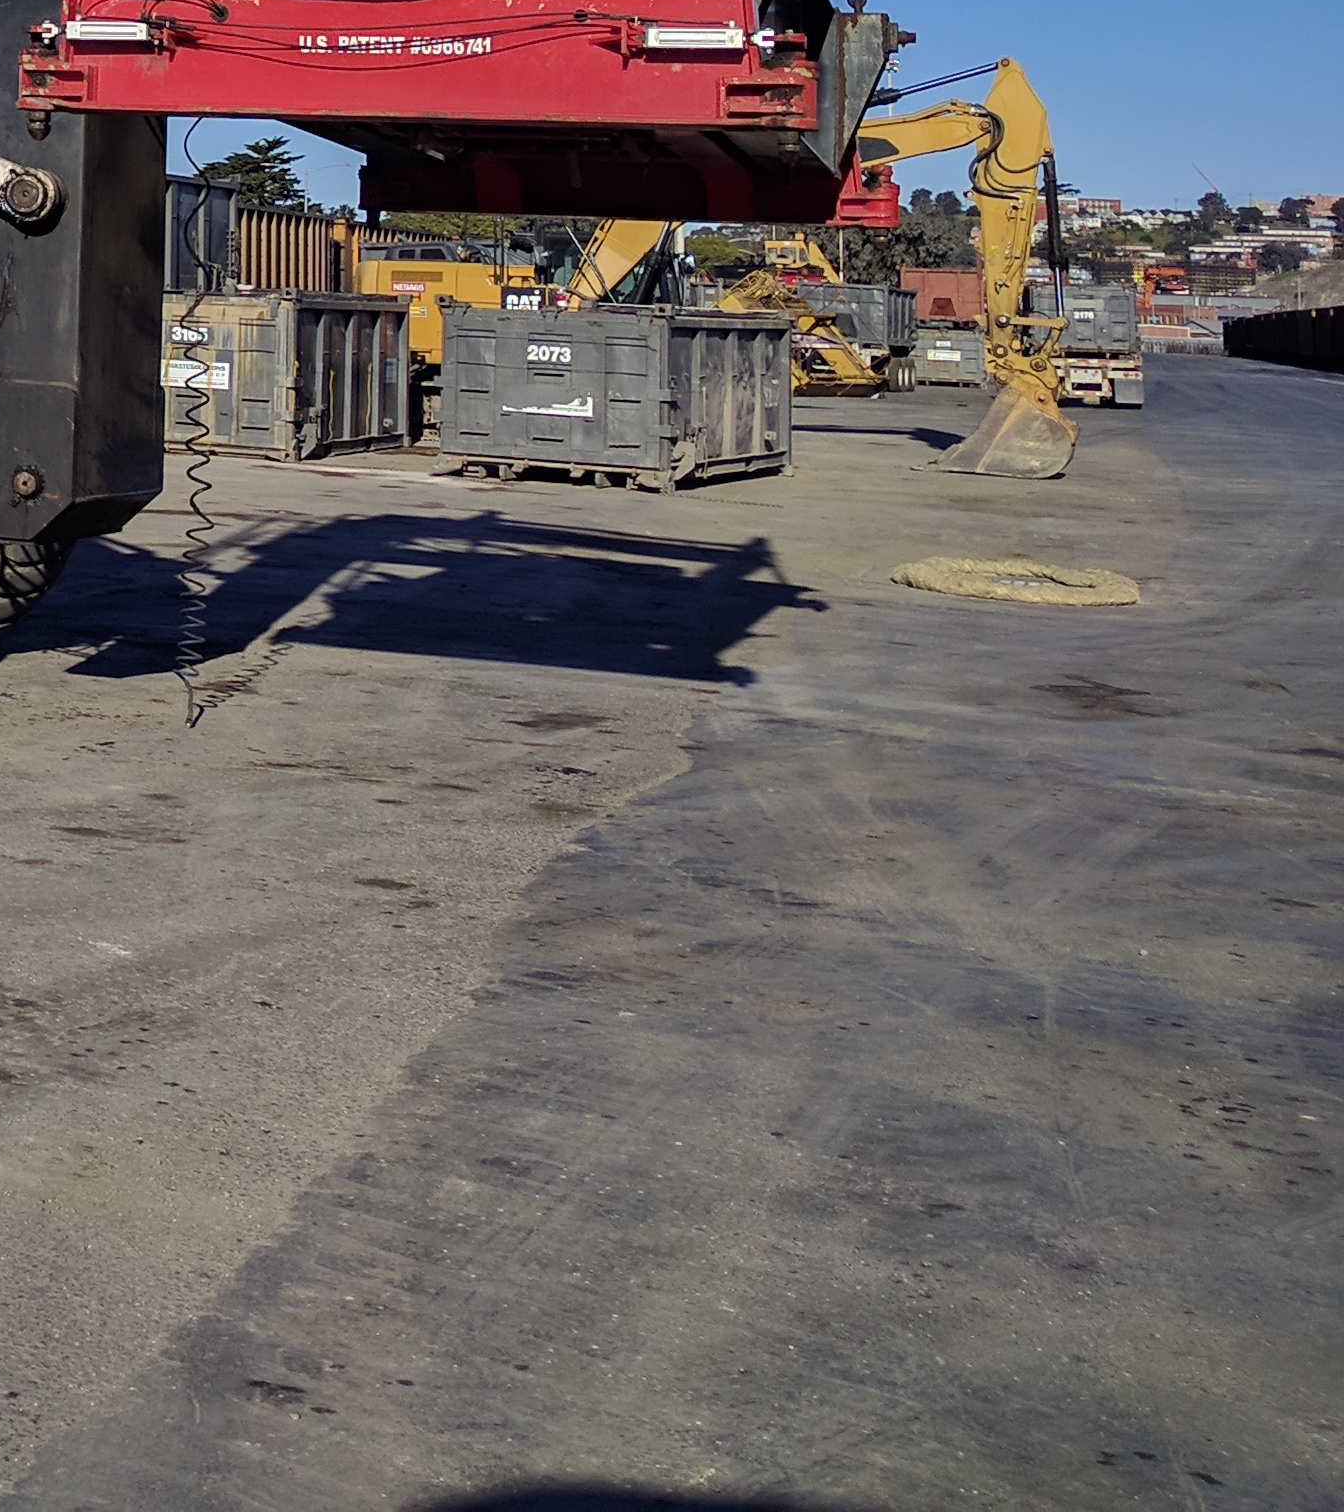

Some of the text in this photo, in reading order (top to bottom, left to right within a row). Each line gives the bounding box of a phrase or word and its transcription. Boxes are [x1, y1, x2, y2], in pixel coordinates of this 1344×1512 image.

[299, 35, 332, 54] U.S.
[338, 35, 406, 54] PATENT
[506, 294, 542, 311] CAT
[526, 344, 572, 363] 2073
